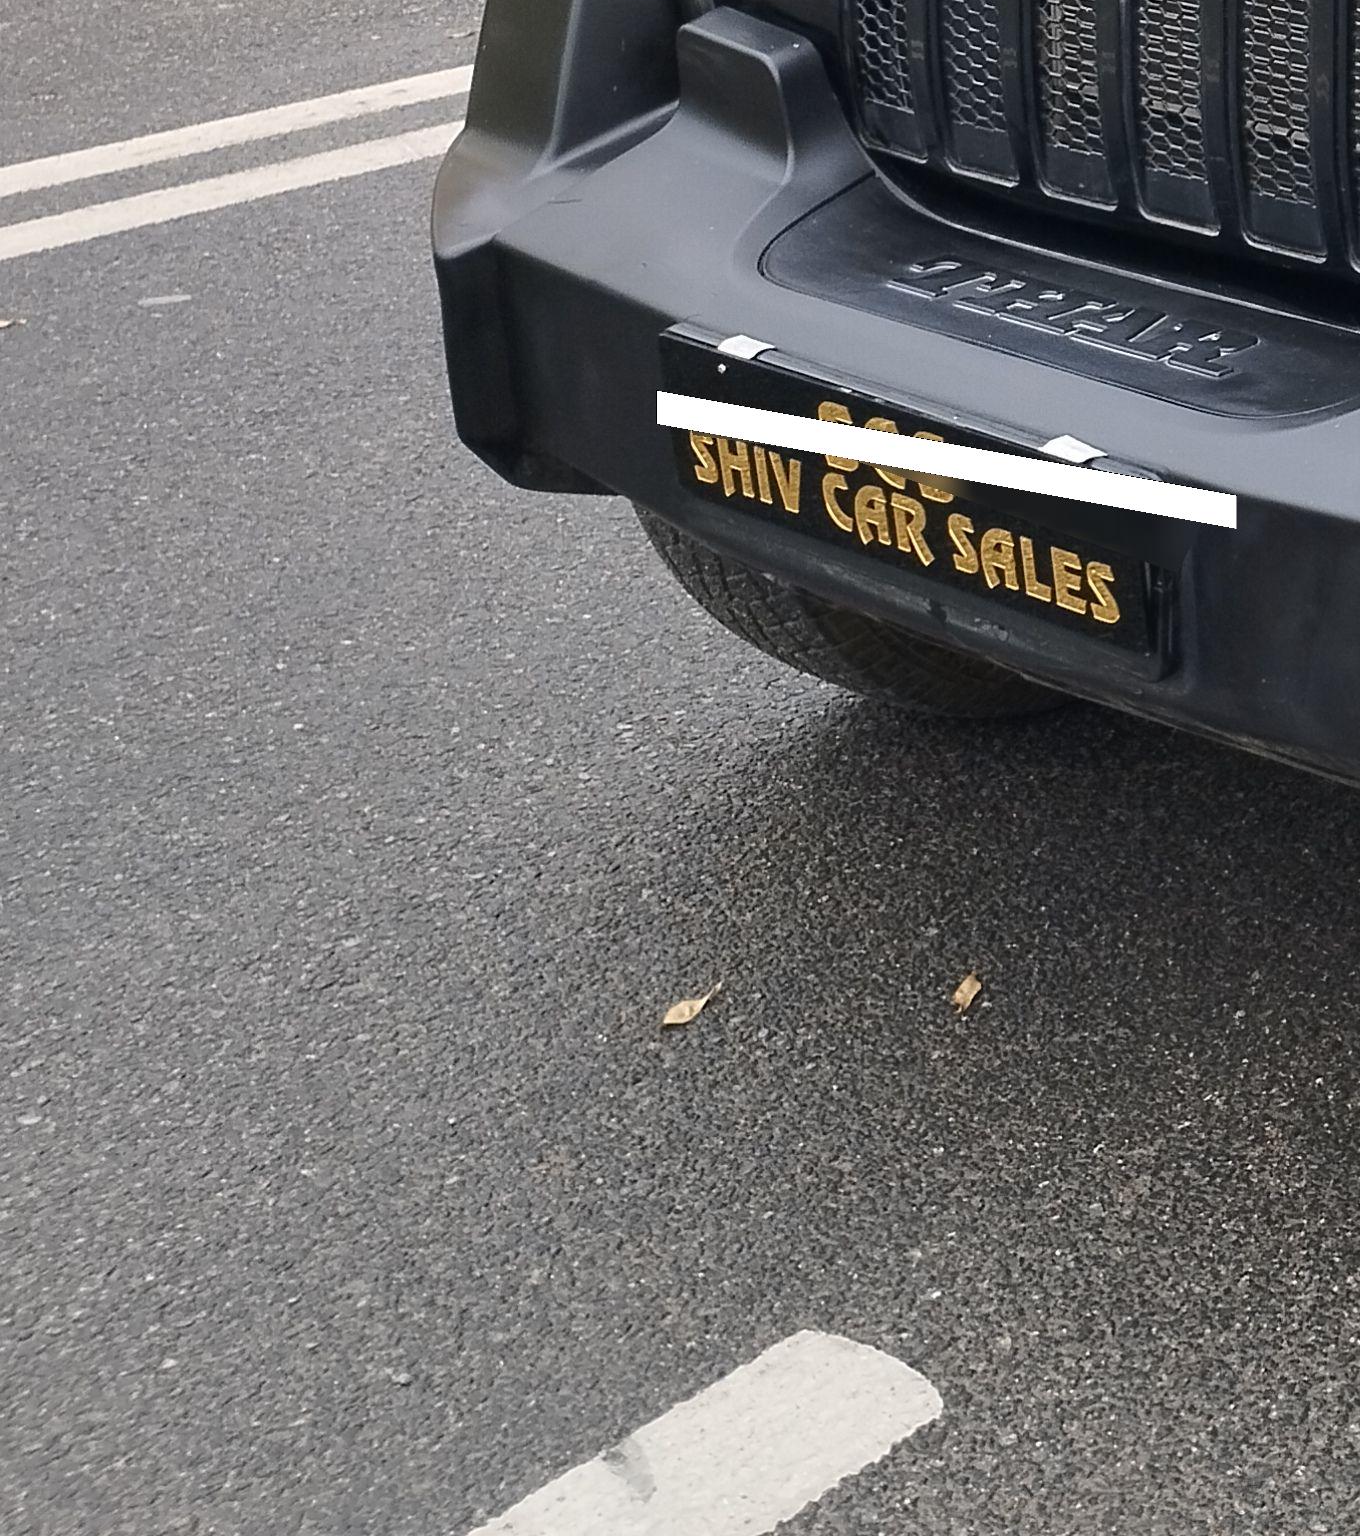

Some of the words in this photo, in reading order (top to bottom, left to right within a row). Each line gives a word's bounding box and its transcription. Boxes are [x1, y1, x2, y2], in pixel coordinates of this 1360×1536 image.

[690, 429, 801, 514] SHIV
[821, 472, 934, 566] CAR
[946, 513, 1121, 624] SALES
